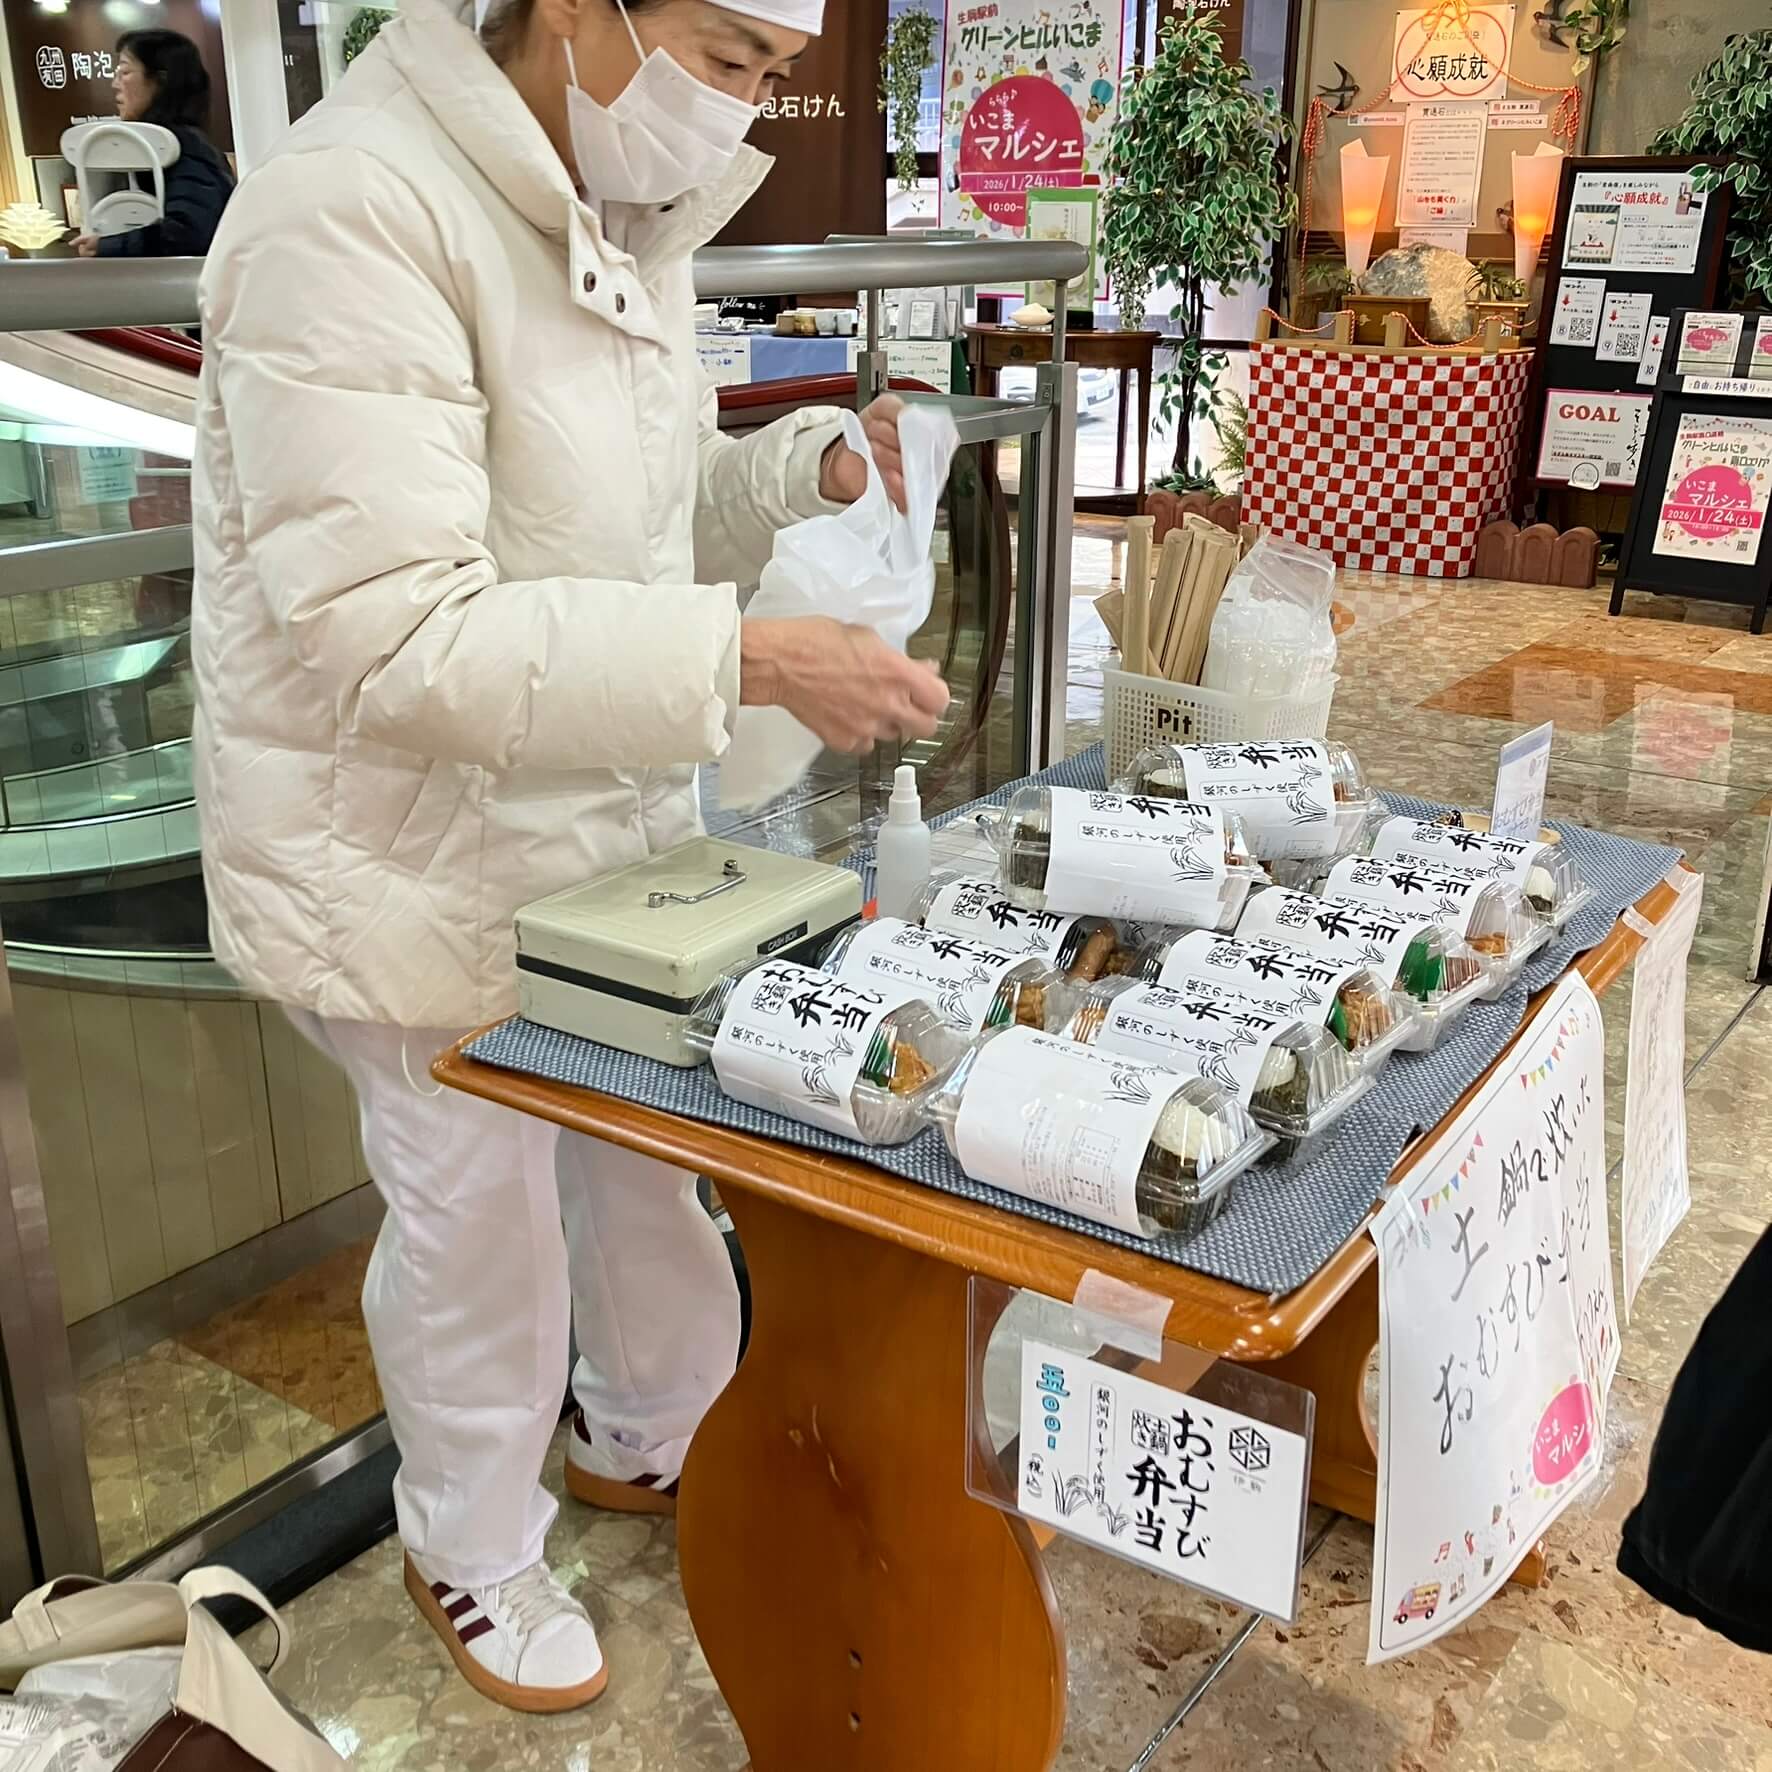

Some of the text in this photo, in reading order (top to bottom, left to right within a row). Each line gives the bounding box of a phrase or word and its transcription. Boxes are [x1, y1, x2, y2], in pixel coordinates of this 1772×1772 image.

[961, 21, 1102, 51] グリーンヒルいこま
[1407, 51, 1489, 82] 心願成就
[969, 111, 1015, 131] いこま
[974, 131, 1082, 163] マルシェ
[1559, 403, 1621, 423] GOAL
[1686, 480, 1717, 492] いこま
[1688, 492, 1749, 510] マルシェ
[1667, 507, 1753, 529] 2026/1/24(土)
[1157, 708, 1193, 735] Pit
[1238, 745, 1317, 769] 弁当
[1126, 797, 1211, 819] 弁当
[1447, 833, 1527, 855] 弁当
[1387, 871, 1471, 896] 弁当
[986, 900, 1065, 933] 弁当
[1314, 910, 1400, 945] 弁当
[930, 940, 1012, 968] 弁当
[1246, 953, 1338, 985] 弁当
[788, 990, 872, 1032] 弁当
[1181, 1001, 1277, 1031] 弁当
[1168, 1408, 1215, 1559] おむすび
[1126, 1455, 1177, 1553] 弁当
